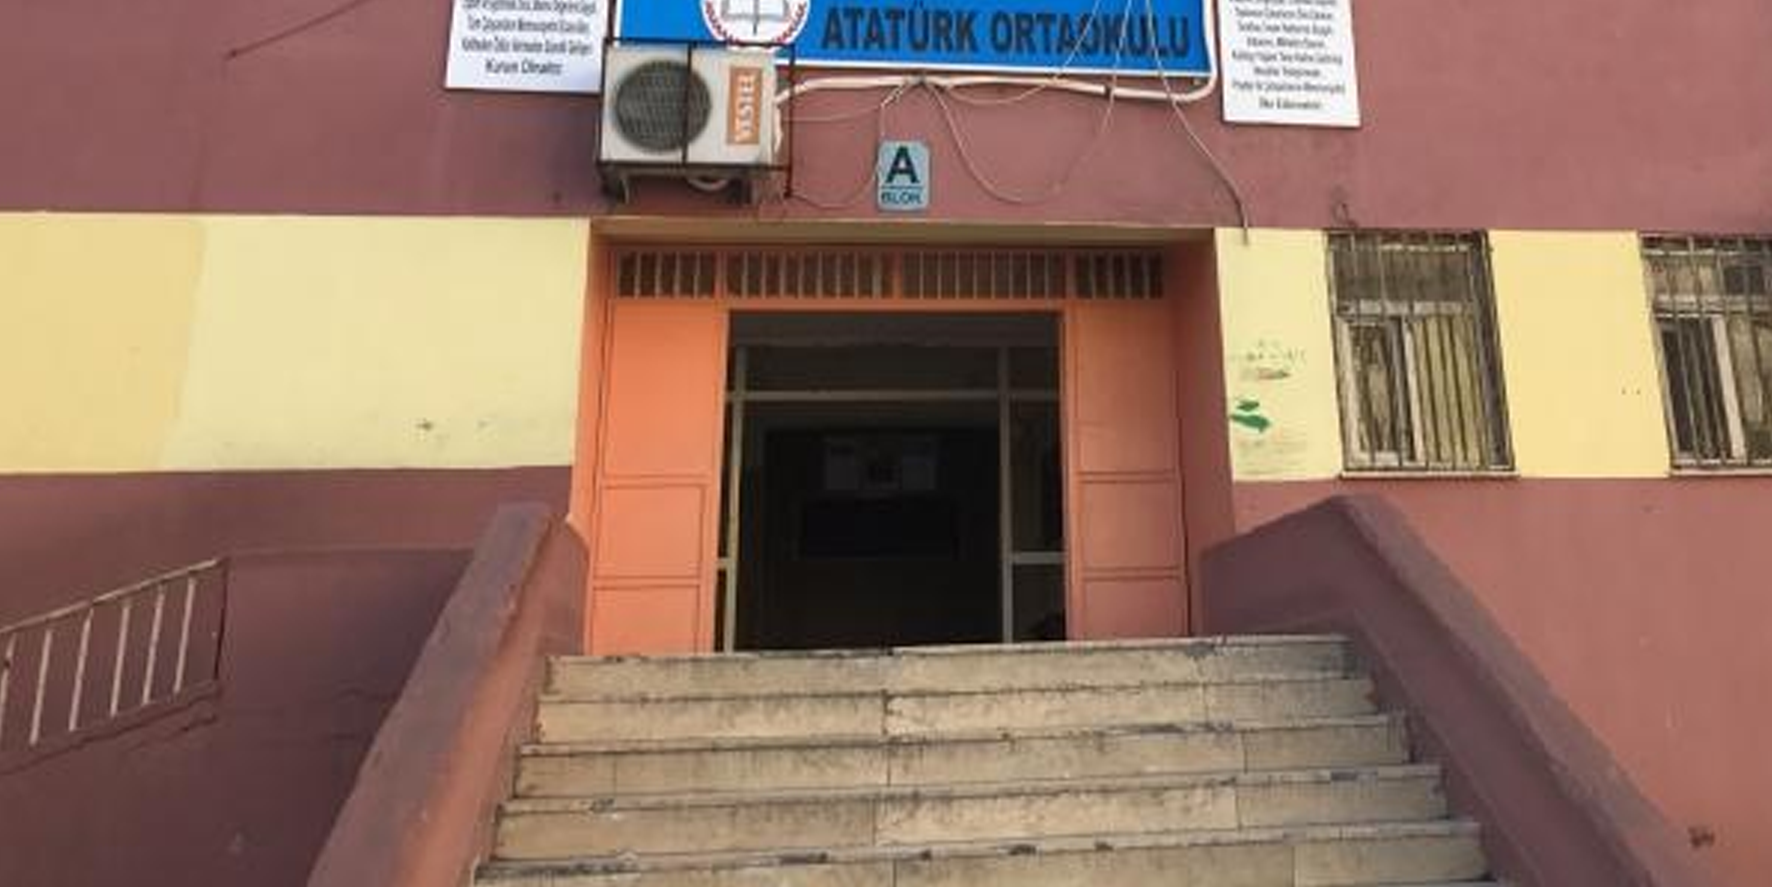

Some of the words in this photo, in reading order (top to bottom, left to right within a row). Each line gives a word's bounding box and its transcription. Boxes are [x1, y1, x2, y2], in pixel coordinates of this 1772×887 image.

[821, 0, 979, 53] ATATÜRK
[991, 11, 1189, 58] ORTAOKULU
[734, 73, 756, 142] VESTEL
[885, 145, 920, 184] A
[881, 192, 922, 204] BLOK
